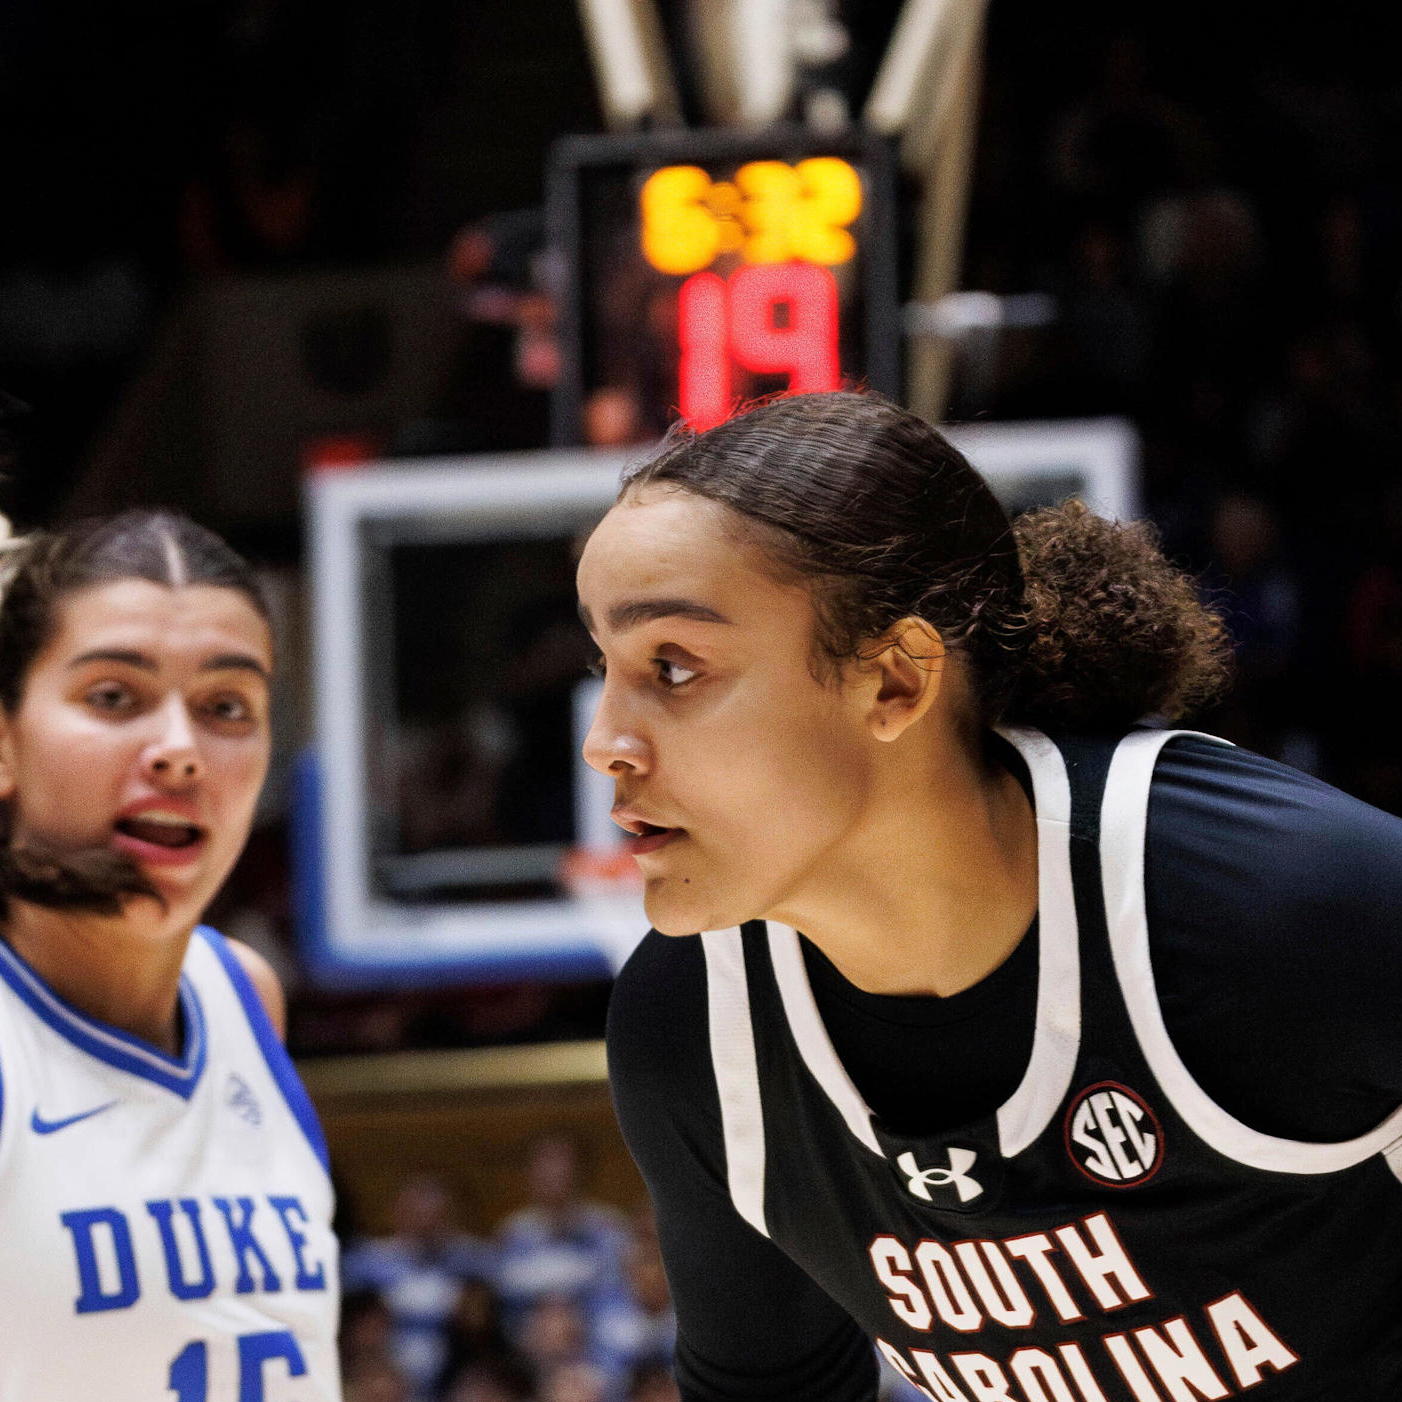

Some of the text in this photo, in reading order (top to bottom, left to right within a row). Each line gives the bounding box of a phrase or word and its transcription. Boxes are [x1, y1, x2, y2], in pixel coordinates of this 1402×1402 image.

[1070, 1092, 1158, 1180] SEC
[60, 1196, 327, 1315] DUKE
[868, 1210, 1153, 1334] SOUTH
